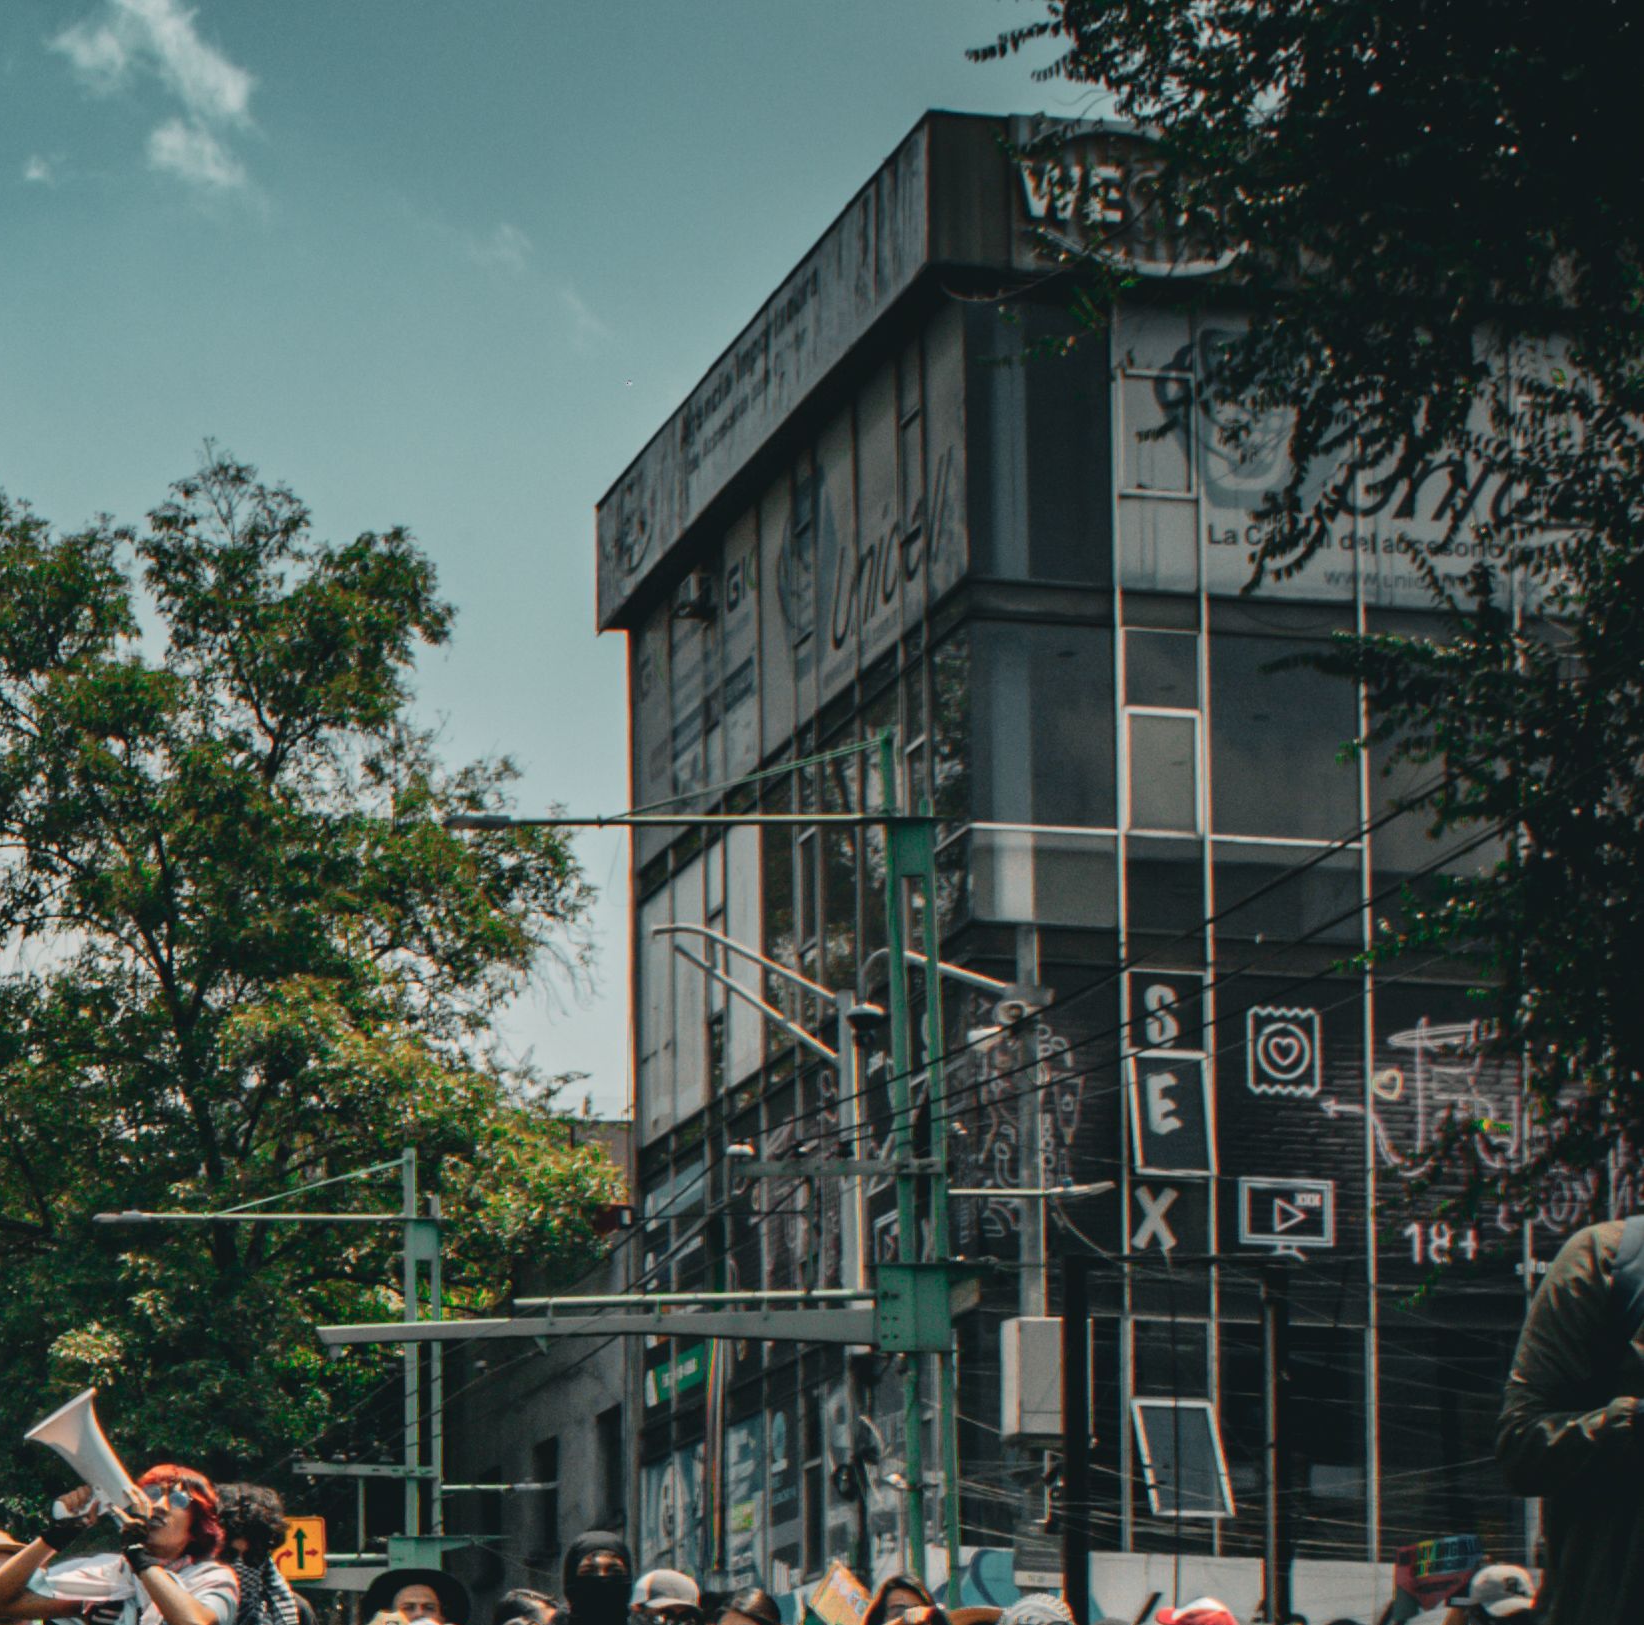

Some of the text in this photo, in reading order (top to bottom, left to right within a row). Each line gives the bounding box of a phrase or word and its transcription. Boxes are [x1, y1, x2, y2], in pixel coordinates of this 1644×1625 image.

[1208, 525, 1238, 546] La
[1339, 532, 1375, 556] del
[1404, 1221, 1479, 1266] 18+
